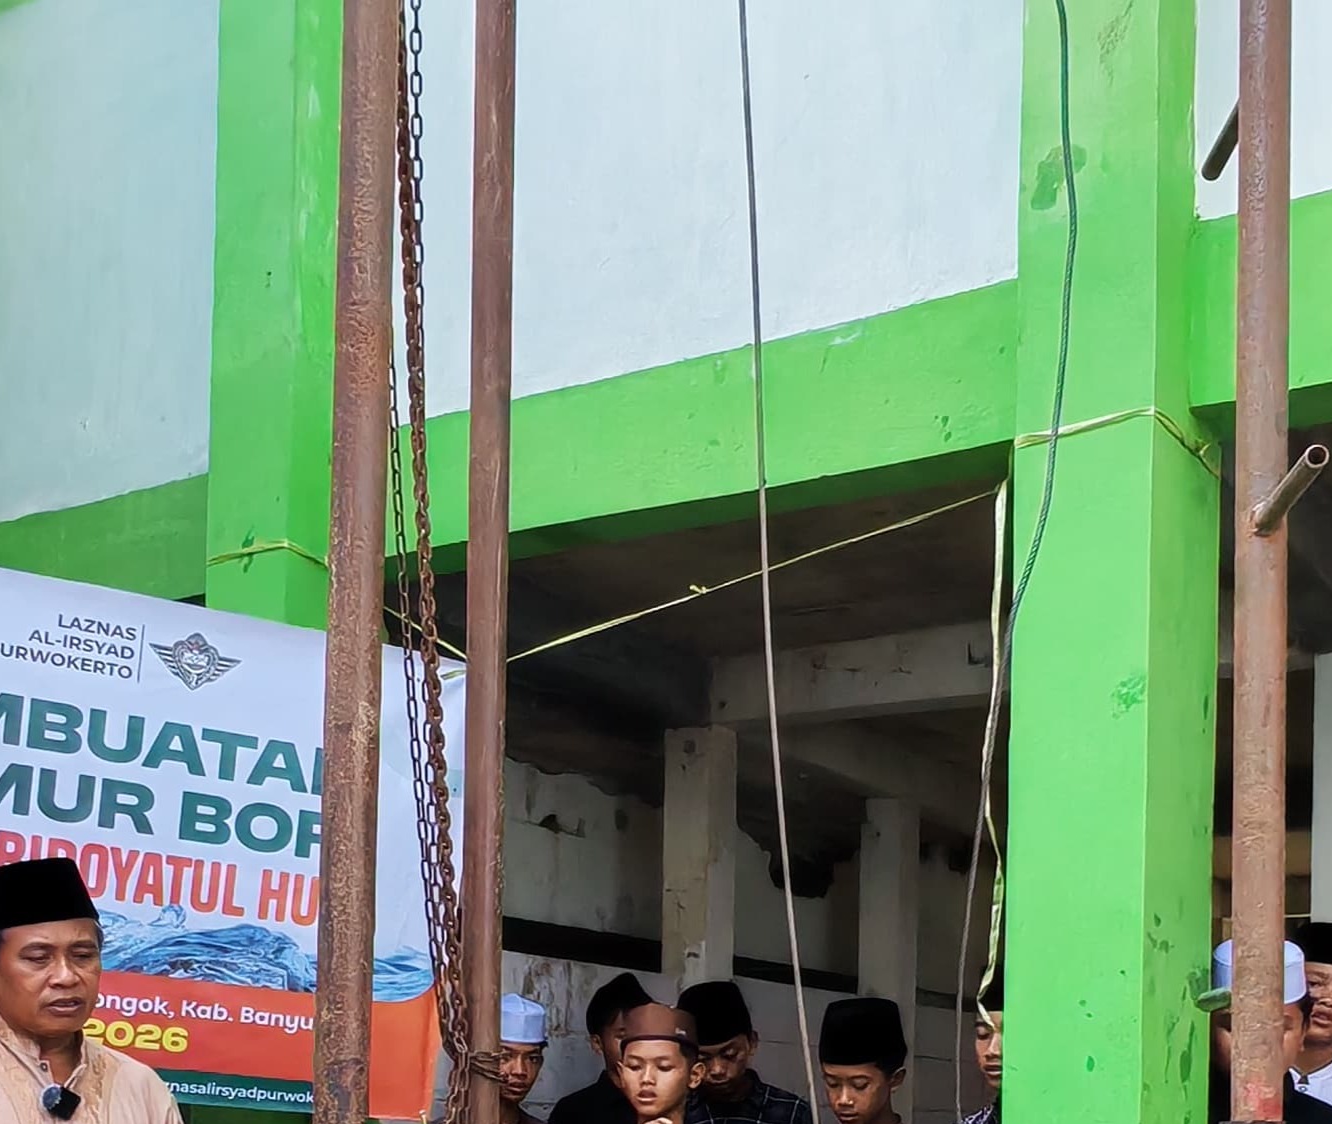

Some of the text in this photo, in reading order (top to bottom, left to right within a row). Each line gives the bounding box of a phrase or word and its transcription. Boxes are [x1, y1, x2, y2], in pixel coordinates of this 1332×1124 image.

[57, 613, 137, 641] LAZNAS
[28, 629, 135, 660] AL-IRSYAD
[181, 1000, 234, 1022] Kab.
[82, 1017, 189, 1053] 2026
[166, 1081, 314, 1104] nasalirsyadpurwok
